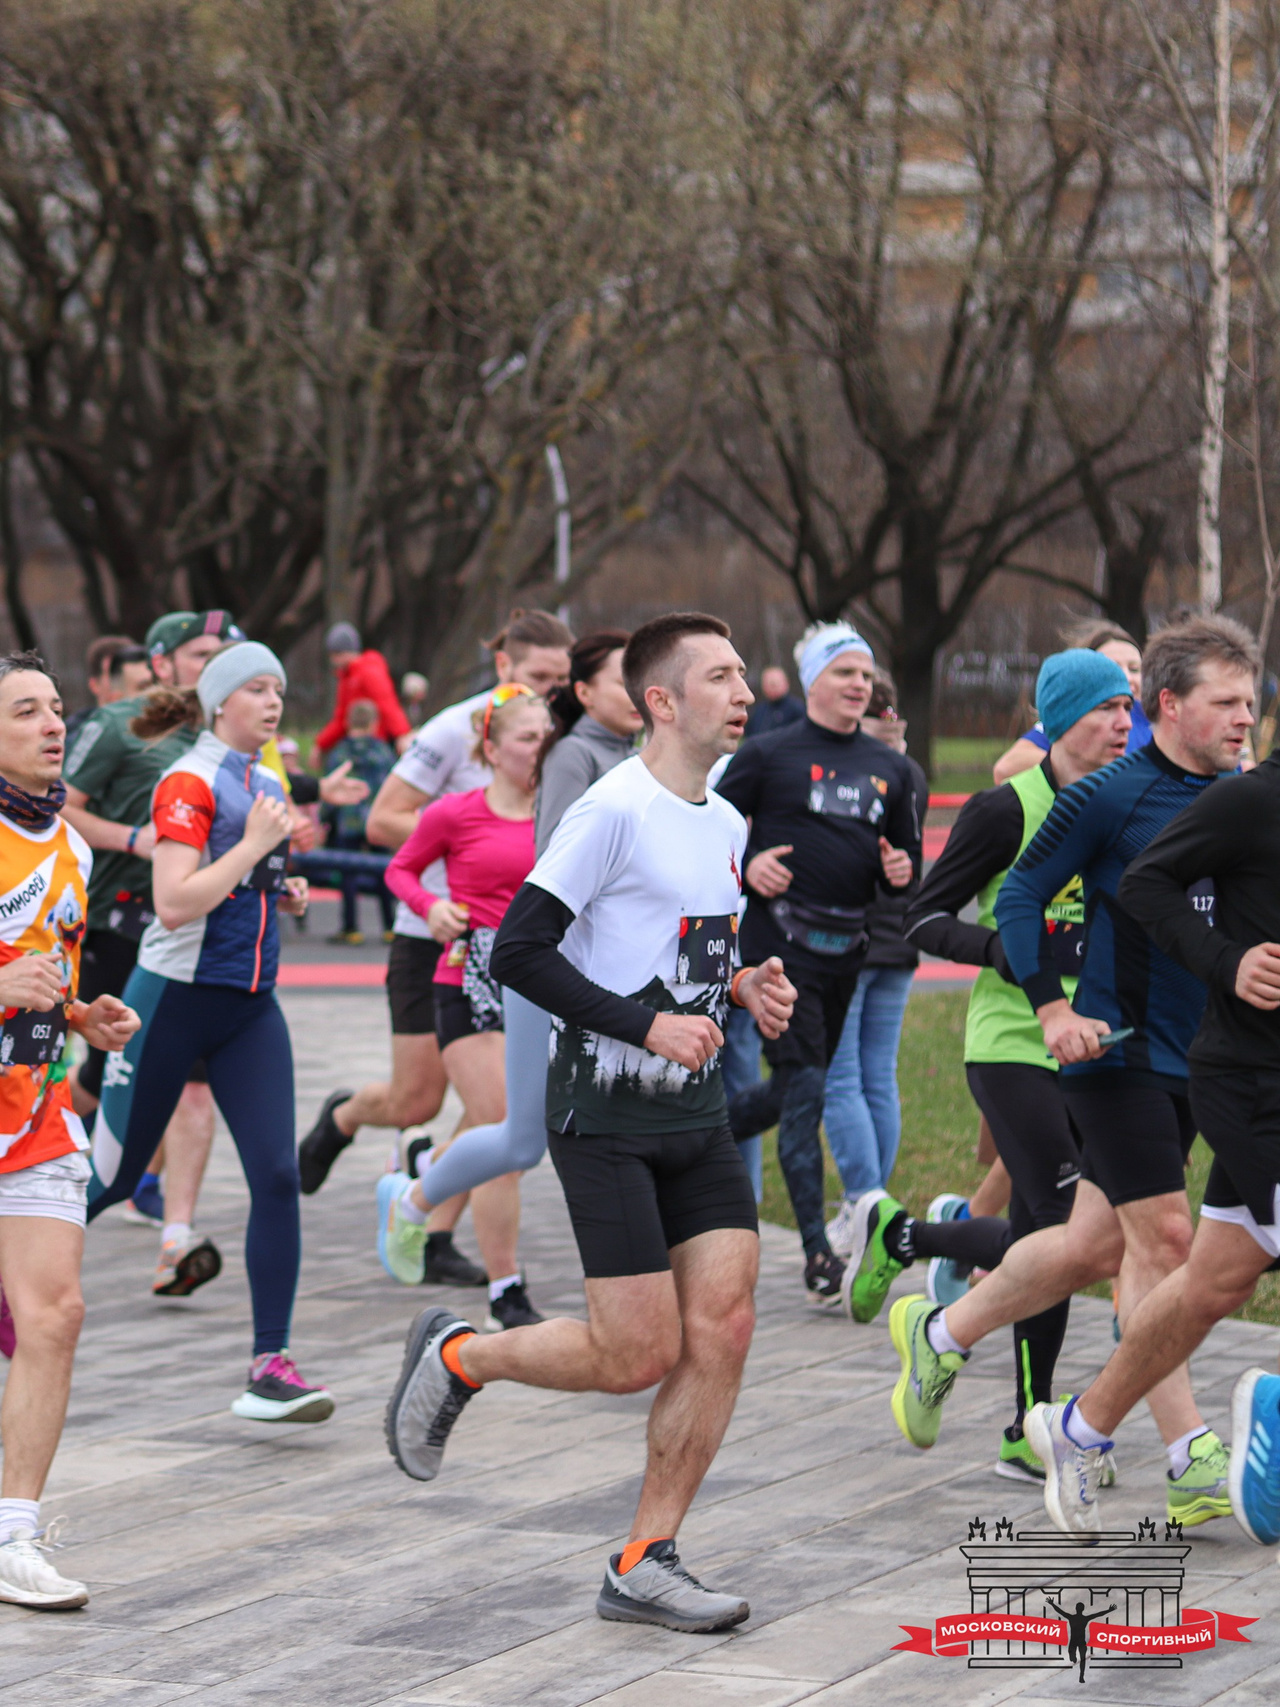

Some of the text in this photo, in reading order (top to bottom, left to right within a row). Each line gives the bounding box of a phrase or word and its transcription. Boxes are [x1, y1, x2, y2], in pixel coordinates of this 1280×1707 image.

[1192, 895, 1215, 912] 117
[707, 939, 725, 956] 040
[32, 1024, 51, 1039] 051
